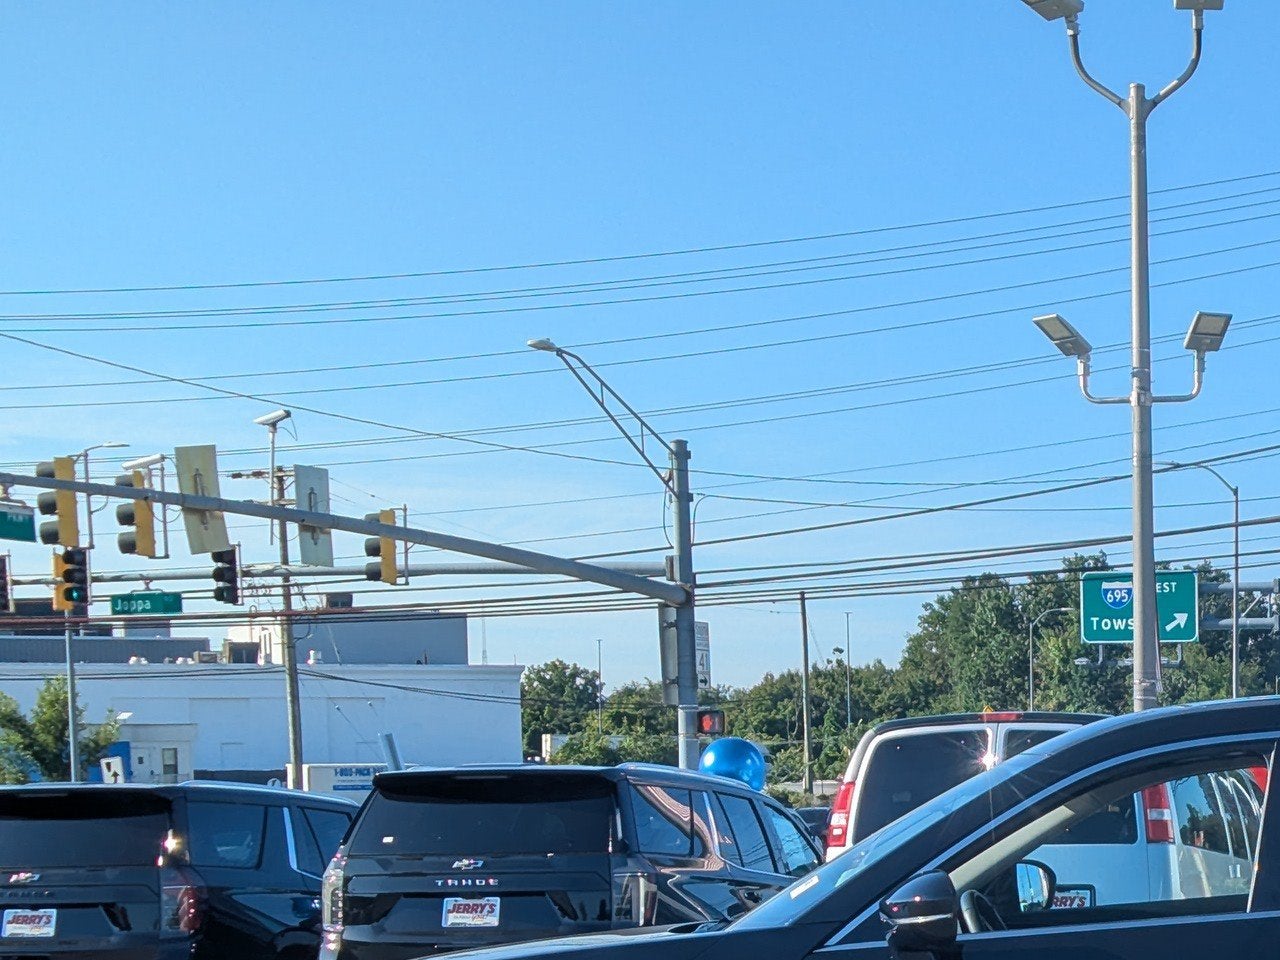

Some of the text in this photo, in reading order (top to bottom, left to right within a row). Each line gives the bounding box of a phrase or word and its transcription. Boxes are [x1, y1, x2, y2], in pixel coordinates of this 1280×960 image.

[1155, 582, 1177, 593] EST
[1106, 589, 1129, 603] 695
[114, 599, 151, 612] Joppa
[435, 878, 499, 887] TAHOE
[1053, 895, 1087, 908] RRY'S
[447, 903, 497, 915] JERRY'S
